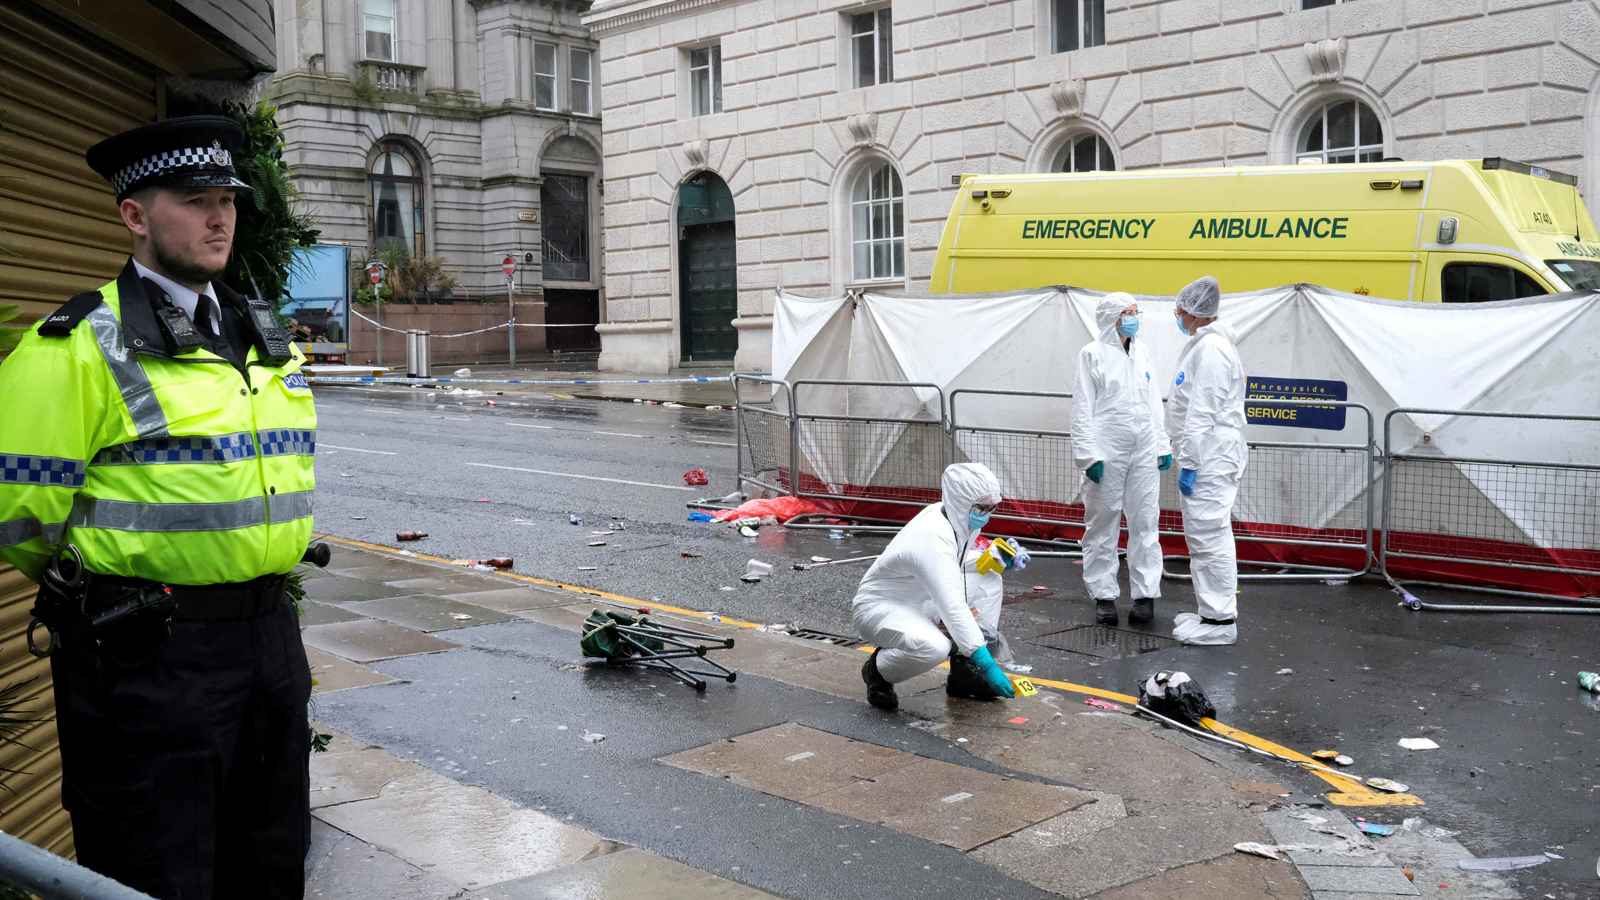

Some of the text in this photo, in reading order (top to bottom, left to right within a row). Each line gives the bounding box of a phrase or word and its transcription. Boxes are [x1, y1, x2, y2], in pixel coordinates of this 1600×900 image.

[1022, 217, 1349, 239] EMERGENCY AMBULANCE
[1249, 382, 1325, 394] Merseyside
[1247, 407, 1297, 420] SERVICE
